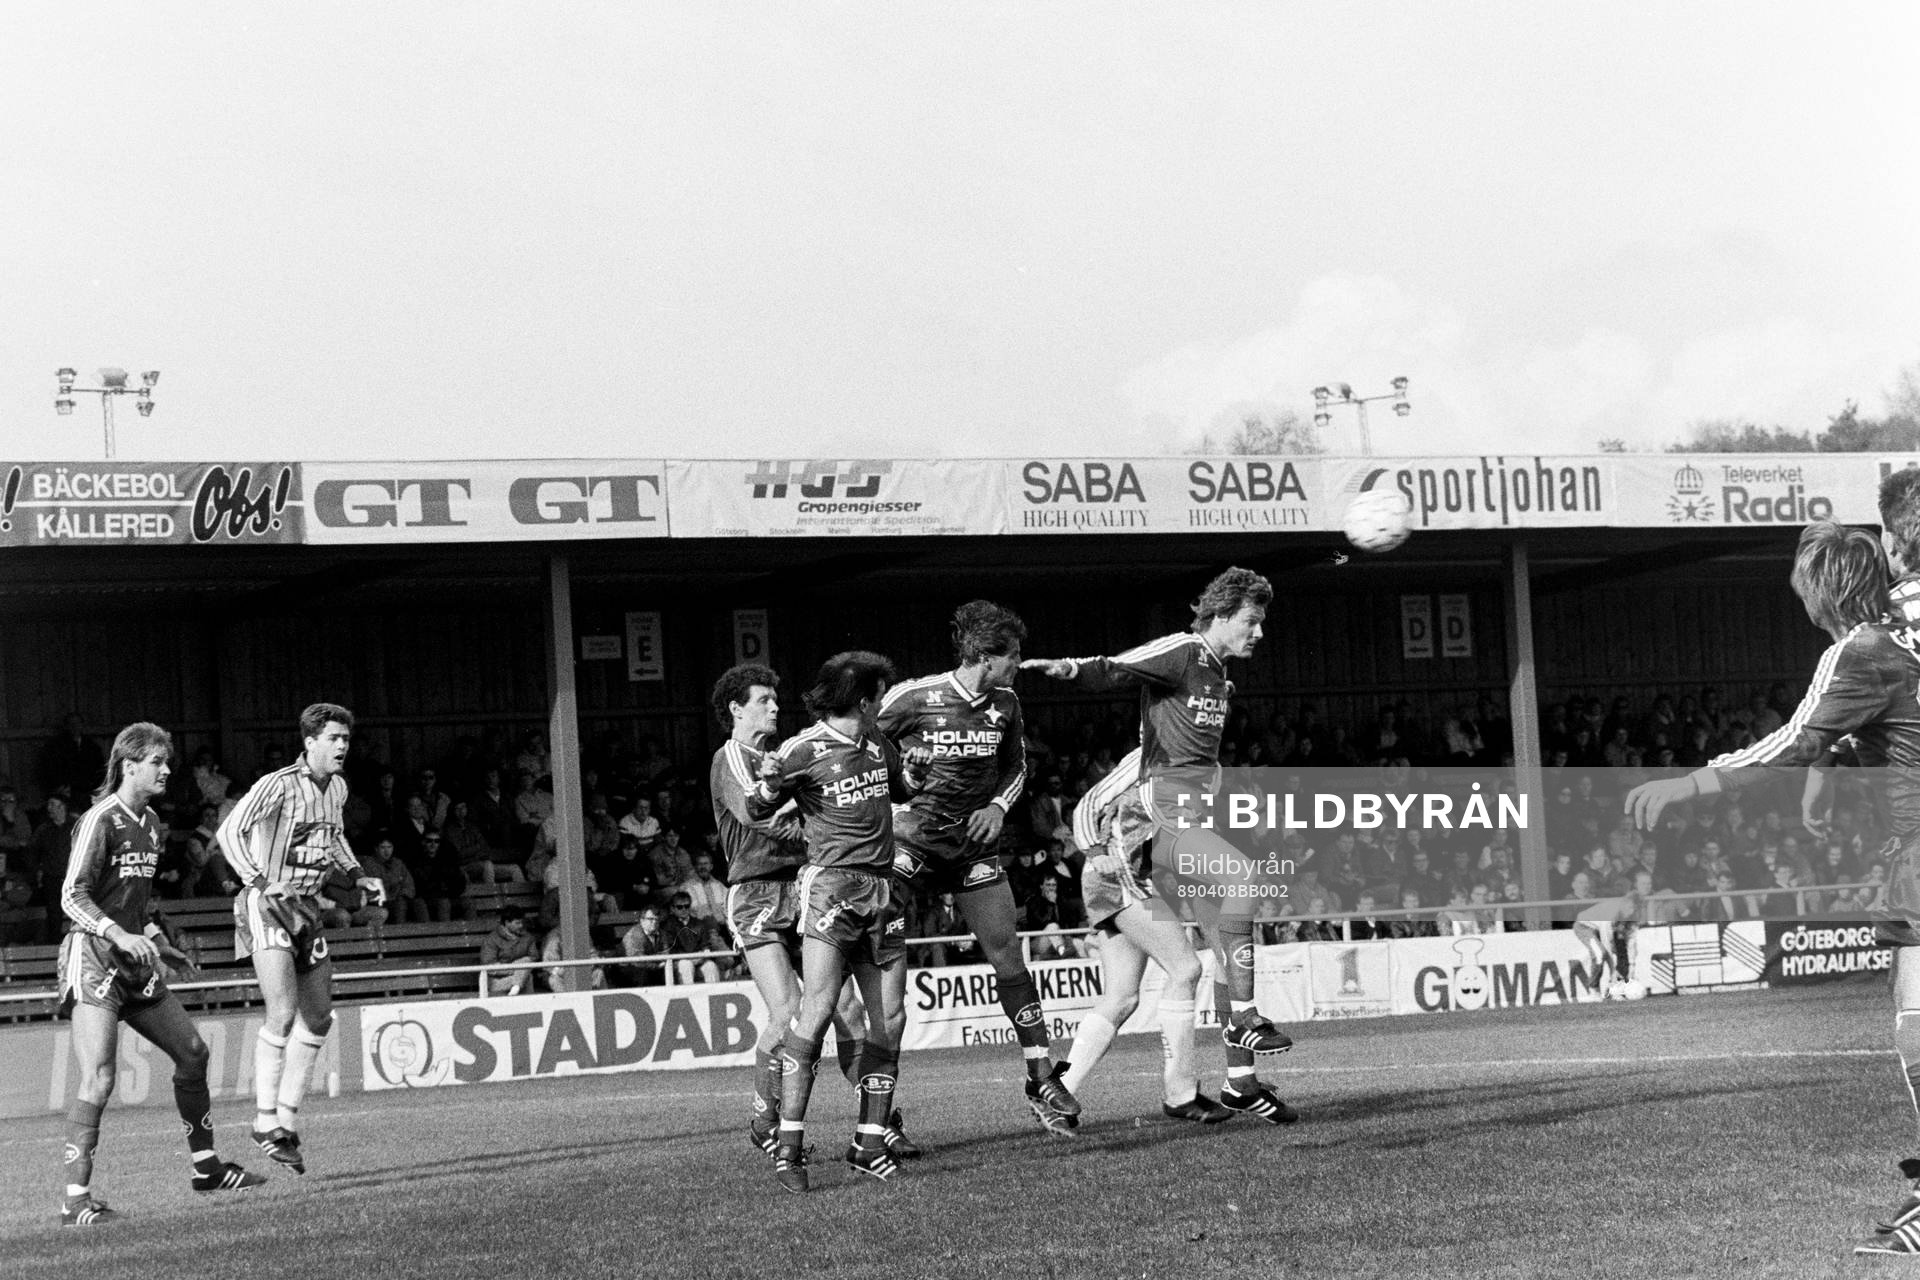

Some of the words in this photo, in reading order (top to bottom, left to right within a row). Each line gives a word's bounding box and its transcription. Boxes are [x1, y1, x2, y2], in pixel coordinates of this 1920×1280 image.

[33, 468, 184, 498] BÄCKEBOL
[1023, 461, 1147, 504] SABA
[1189, 461, 1308, 503] SABA
[1721, 465, 1803, 483] Televerket
[191, 465, 291, 541] Obs!
[314, 479, 471, 527] GT
[508, 475, 659, 524] GT
[798, 501, 921, 514] Gropengiesser
[1722, 485, 1833, 523] Radio
[37, 508, 174, 538] KÅLLERED
[1023, 510, 1068, 527] HIGH
[1073, 510, 1149, 530] QUALITY
[1189, 509, 1232, 526] HIGH
[1237, 508, 1310, 530] QUALITY
[932, 744, 998, 757] PAPER
[1782, 949, 1894, 976] HYDRAULIKSE
[916, 965, 1103, 1011] SPARBKERN
[452, 993, 759, 1083] STADAB
